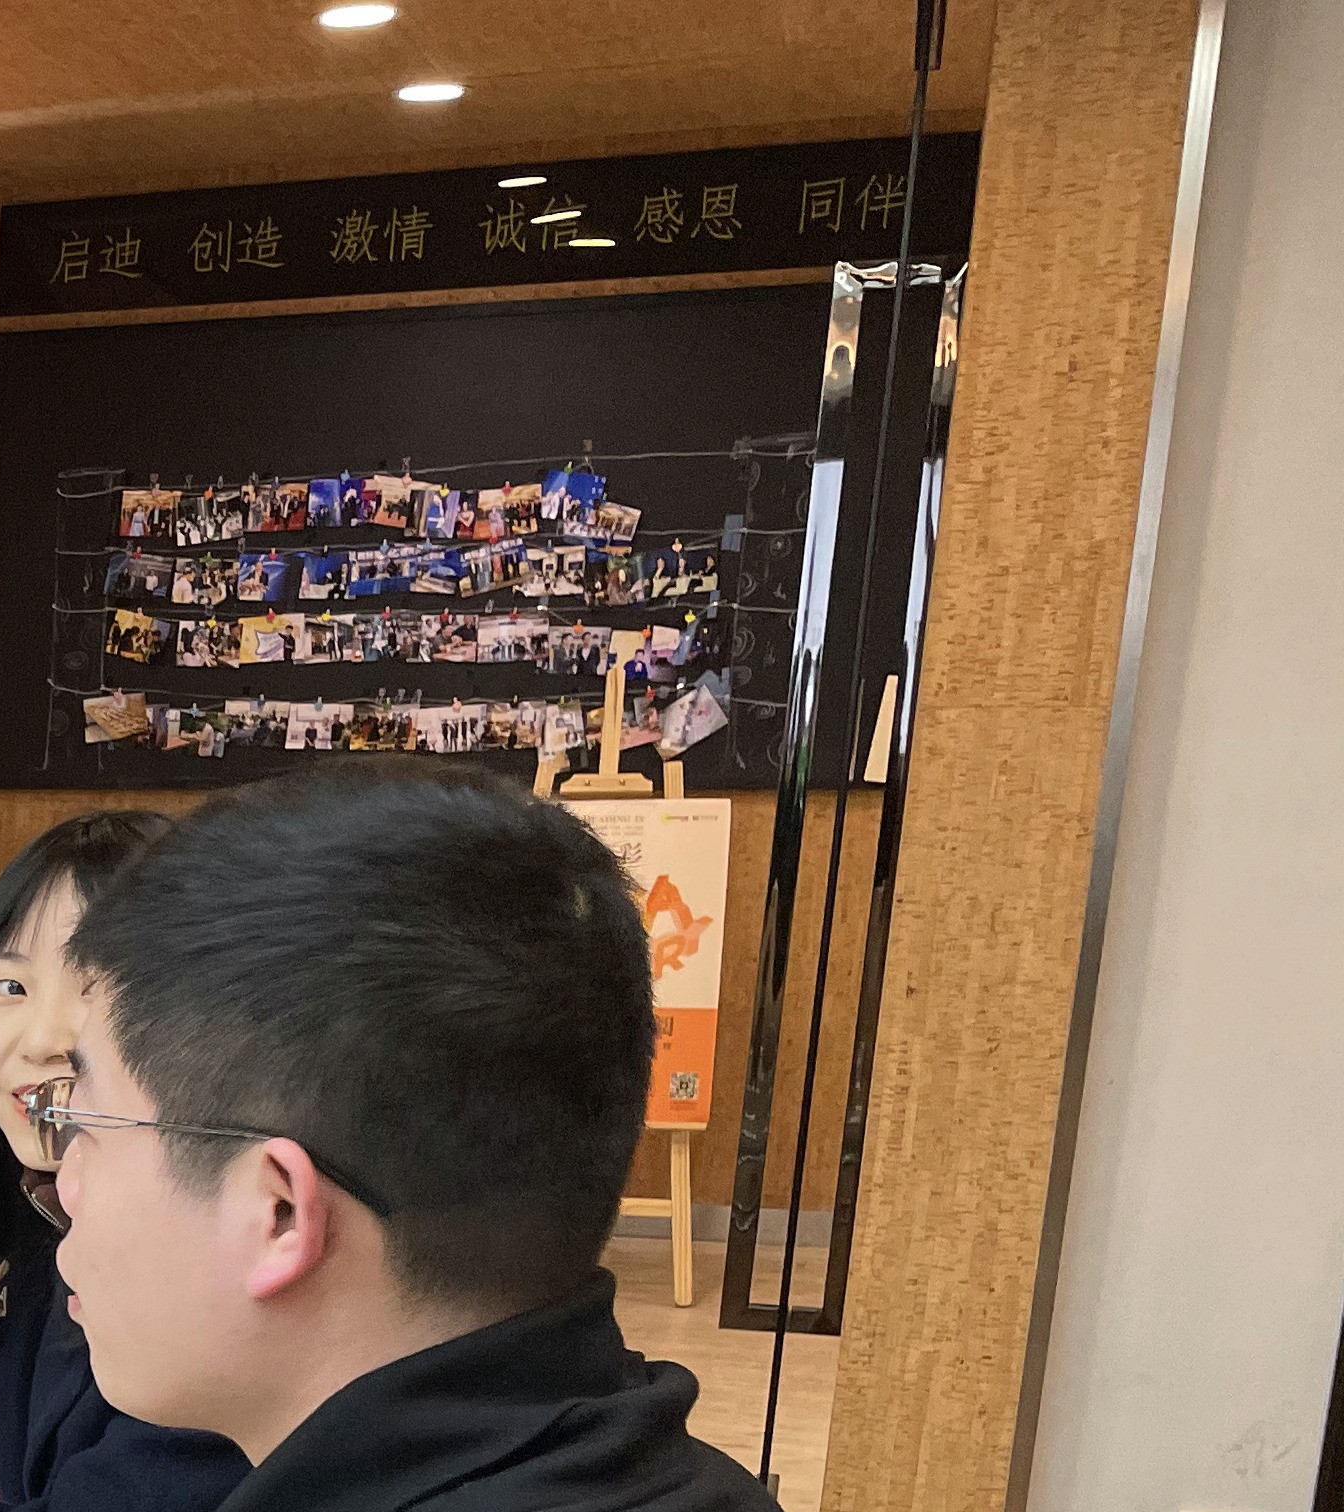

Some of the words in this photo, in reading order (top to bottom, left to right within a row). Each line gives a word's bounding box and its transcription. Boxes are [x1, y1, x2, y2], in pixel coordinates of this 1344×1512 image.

[51, 229, 145, 284] 启迪
[186, 219, 286, 276] 创造
[329, 209, 436, 265] 激情
[478, 195, 588, 256] 诚信
[634, 182, 744, 245] 感恩
[798, 174, 910, 234] 同伴
